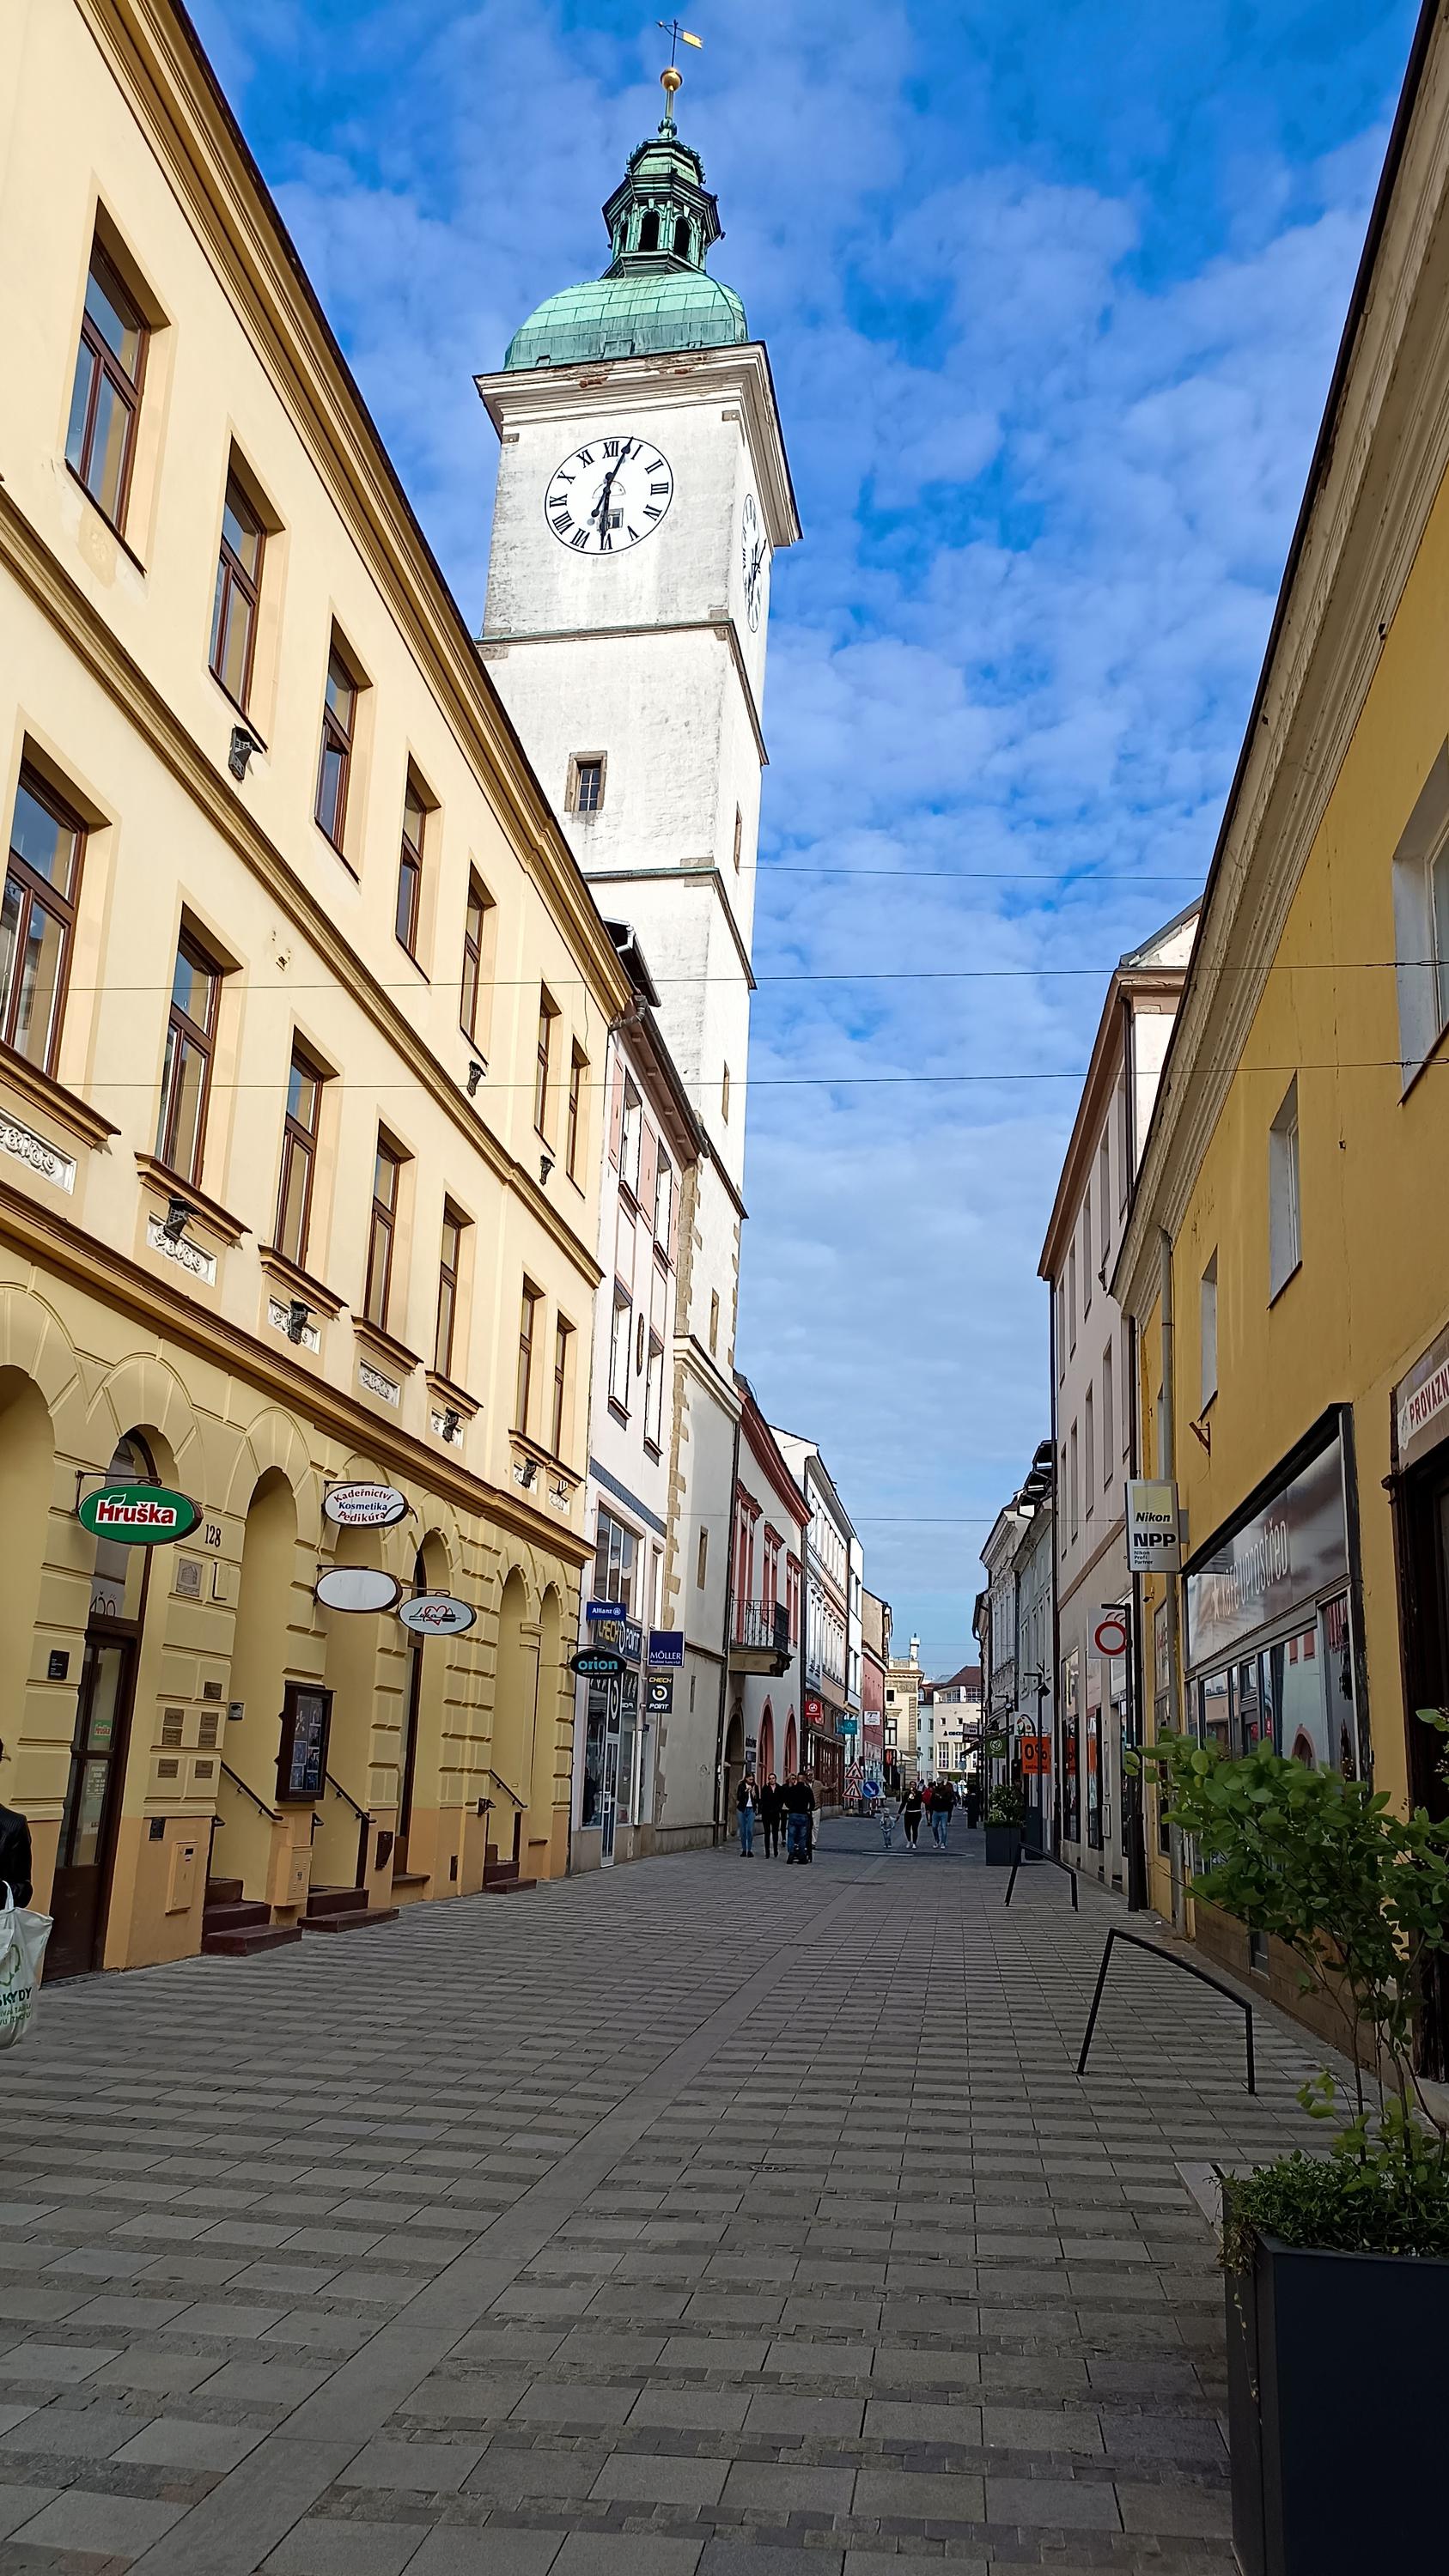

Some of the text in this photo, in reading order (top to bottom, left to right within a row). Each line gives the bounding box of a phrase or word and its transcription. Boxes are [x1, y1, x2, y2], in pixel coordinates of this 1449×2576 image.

[602, 440, 620, 459] XII
[630, 444, 643, 460] I
[575, 448, 595, 469] XI
[644, 459, 664, 474] II
[557, 470, 576, 484] X
[649, 482, 669, 495] III
[549, 494, 568, 508] IX
[642, 504, 662, 521] IV
[551, 510, 575, 535] VIII
[569, 527, 591, 549] VII
[627, 525, 640, 542] V
[1409, 1363, 1449, 1430] PROVAZN
[333, 1488, 394, 1504] Kadeřnictví
[98, 1500, 175, 1525] Hruška
[338, 1502, 388, 1511] Kosmetika
[337, 1510, 387, 1522] Pedikúra
[1135, 1512, 1171, 1522] Nikon
[204, 1524, 222, 1547] 128
[1134, 1533, 1176, 1547] NPP
[578, 1656, 618, 1670] orion
[650, 1650, 681, 1660] MÖLLER
